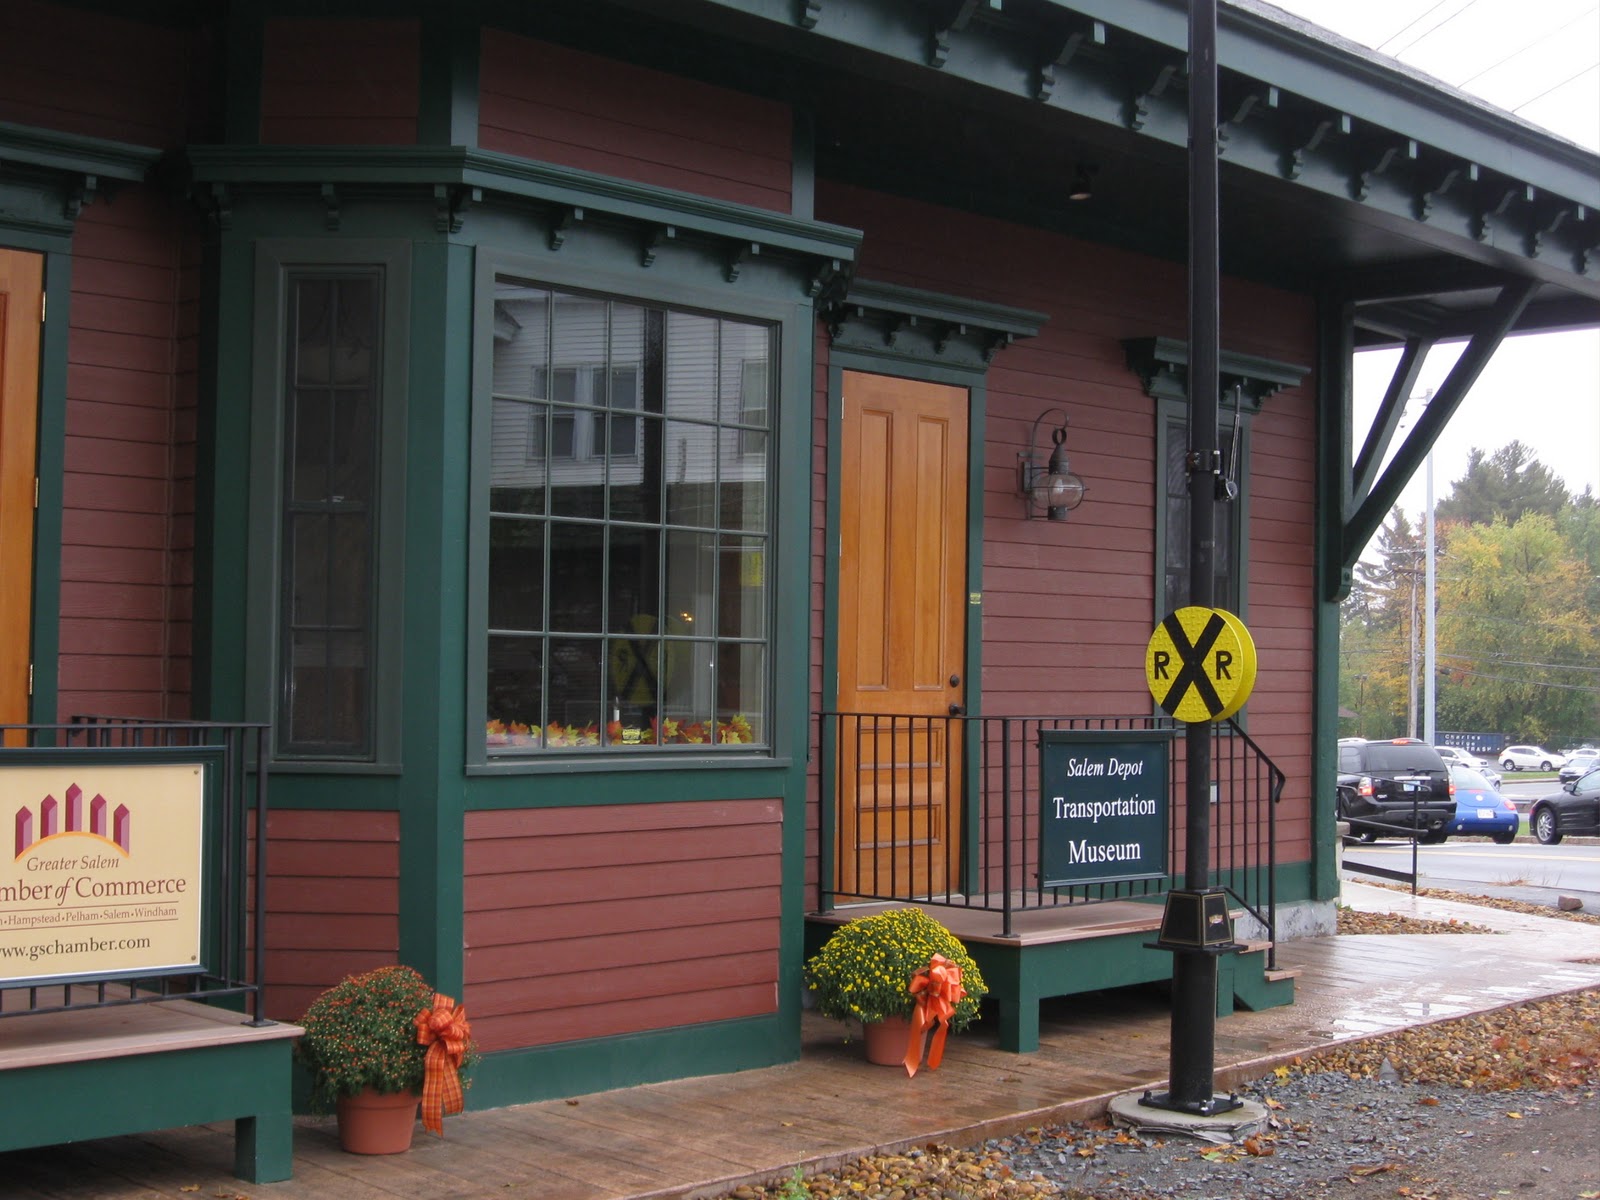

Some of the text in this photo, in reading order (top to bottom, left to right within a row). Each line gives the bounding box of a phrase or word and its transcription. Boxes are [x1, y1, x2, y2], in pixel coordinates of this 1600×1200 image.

[1154, 651, 1170, 680] R
[1216, 650, 1233, 680] R
[1067, 758, 1143, 780] Salem Depot
[1053, 794, 1156, 823] Transportation
[26, 855, 119, 871] Greater Salem
[1068, 839, 1141, 864] Museum
[54, 877, 75, 906] of
[75, 877, 186, 898] Commerce
[134, 907, 177, 918] Windham
[0, 937, 151, 961] ww.gschamber.com
